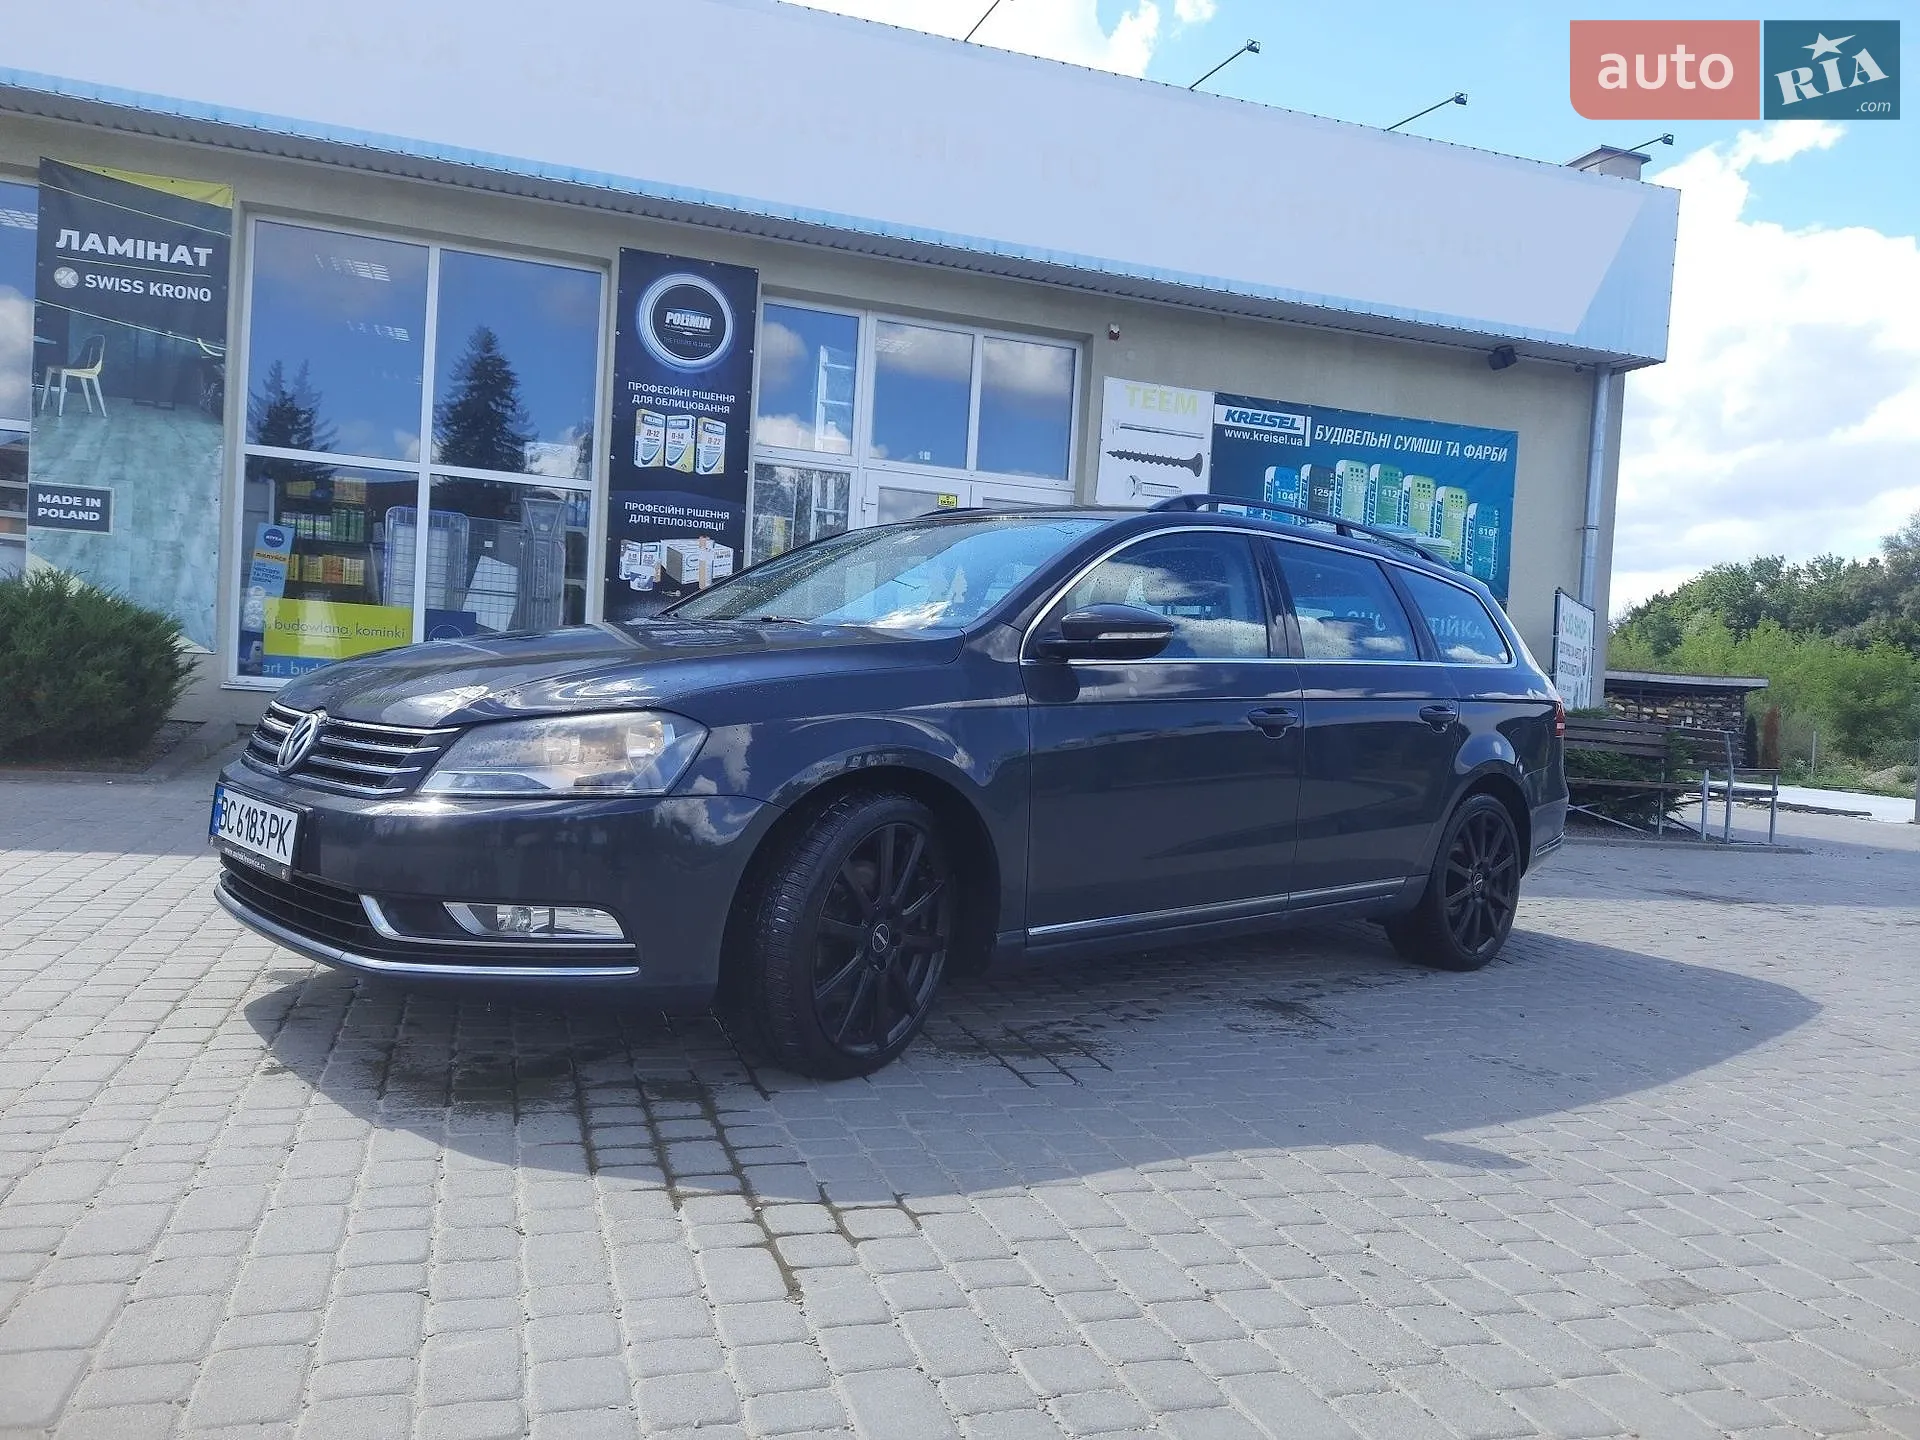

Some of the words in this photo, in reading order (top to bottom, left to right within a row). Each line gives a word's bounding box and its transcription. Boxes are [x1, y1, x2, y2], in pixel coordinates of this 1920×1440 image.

[55, 228, 213, 267] ЛАМІНАТ
[84, 274, 145, 294] SWISS
[149, 281, 212, 303] KRONO
[628, 381, 690, 398] ПРОФЕСІЙНІ
[692, 390, 736, 403] РІШЕННЯ
[1125, 385, 1198, 415] TEEM
[632, 394, 653, 405] ДЛЯ
[655, 397, 730, 414] ОБЛИЦЮВАННЯ
[1224, 408, 1301, 432] KREISEL
[1224, 428, 1303, 447] www.kreisel.ua
[1314, 425, 1391, 449] БУДІВЕЛЬНІ
[1394, 435, 1442, 455] СУМІШІ
[1445, 441, 1460, 456] ТА
[1463, 444, 1509, 463] ФАРБИ
[37, 493, 83, 507] MADE
[85, 497, 101, 507] IN
[1313, 488, 1329, 498] 125
[1381, 488, 1398, 498] 412
[37, 507, 100, 521] POLAND
[624, 501, 684, 516] ПРОФЕСІЙНІ
[686, 508, 730, 520] РІШЕННЯ
[629, 514, 650, 524] ДЛЯ
[652, 516, 726, 532] ТЕПЛОІЗОЛЯЦІЇ
[1478, 527, 1494, 537] 810
[355, 622, 405, 640] kominki
[219, 796, 293, 857] BC6183PK
